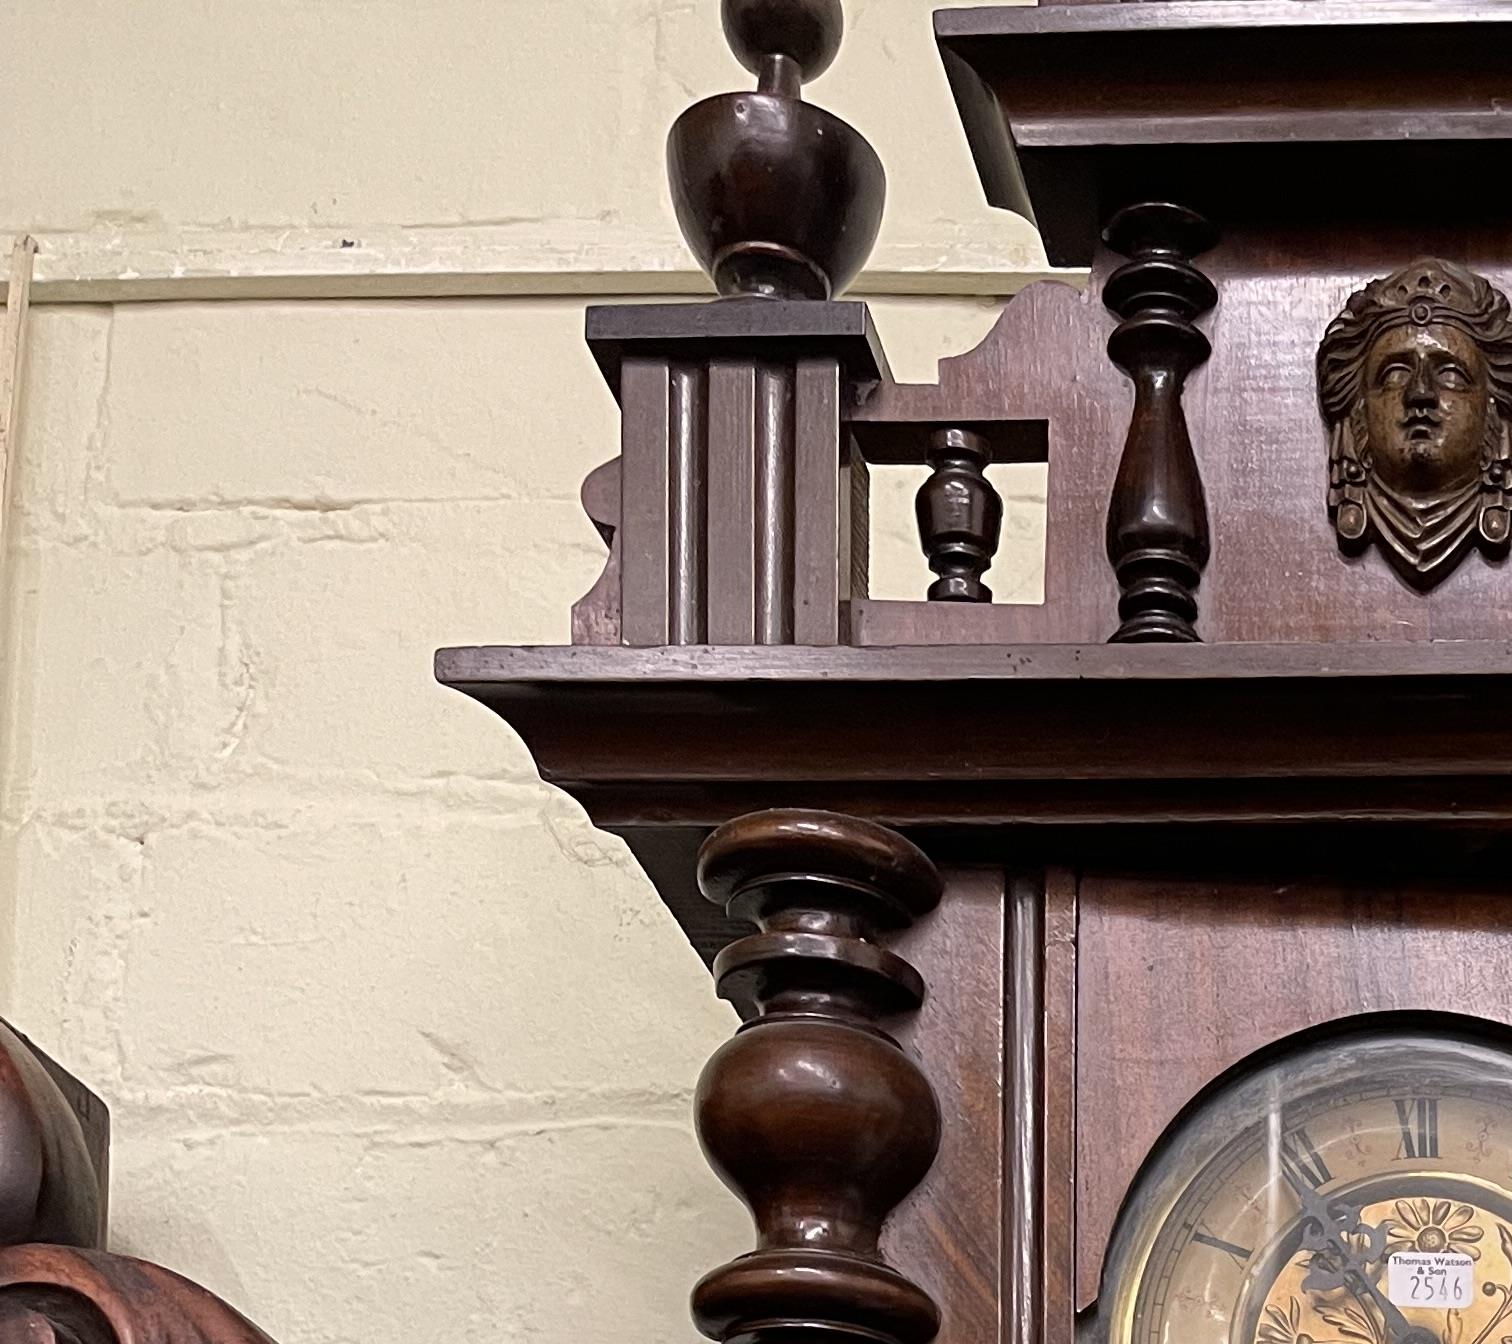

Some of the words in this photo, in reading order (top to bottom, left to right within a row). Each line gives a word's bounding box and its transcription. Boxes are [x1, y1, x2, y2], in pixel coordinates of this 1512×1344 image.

[1391, 1098, 1444, 1161] XII
[1392, 1256, 1431, 1265] Thomas
[1434, 1257, 1472, 1266] Watson
[1417, 1267, 1424, 1275] &
[1428, 1267, 1447, 1275] Son
[1410, 1276, 1462, 1300] 2546
